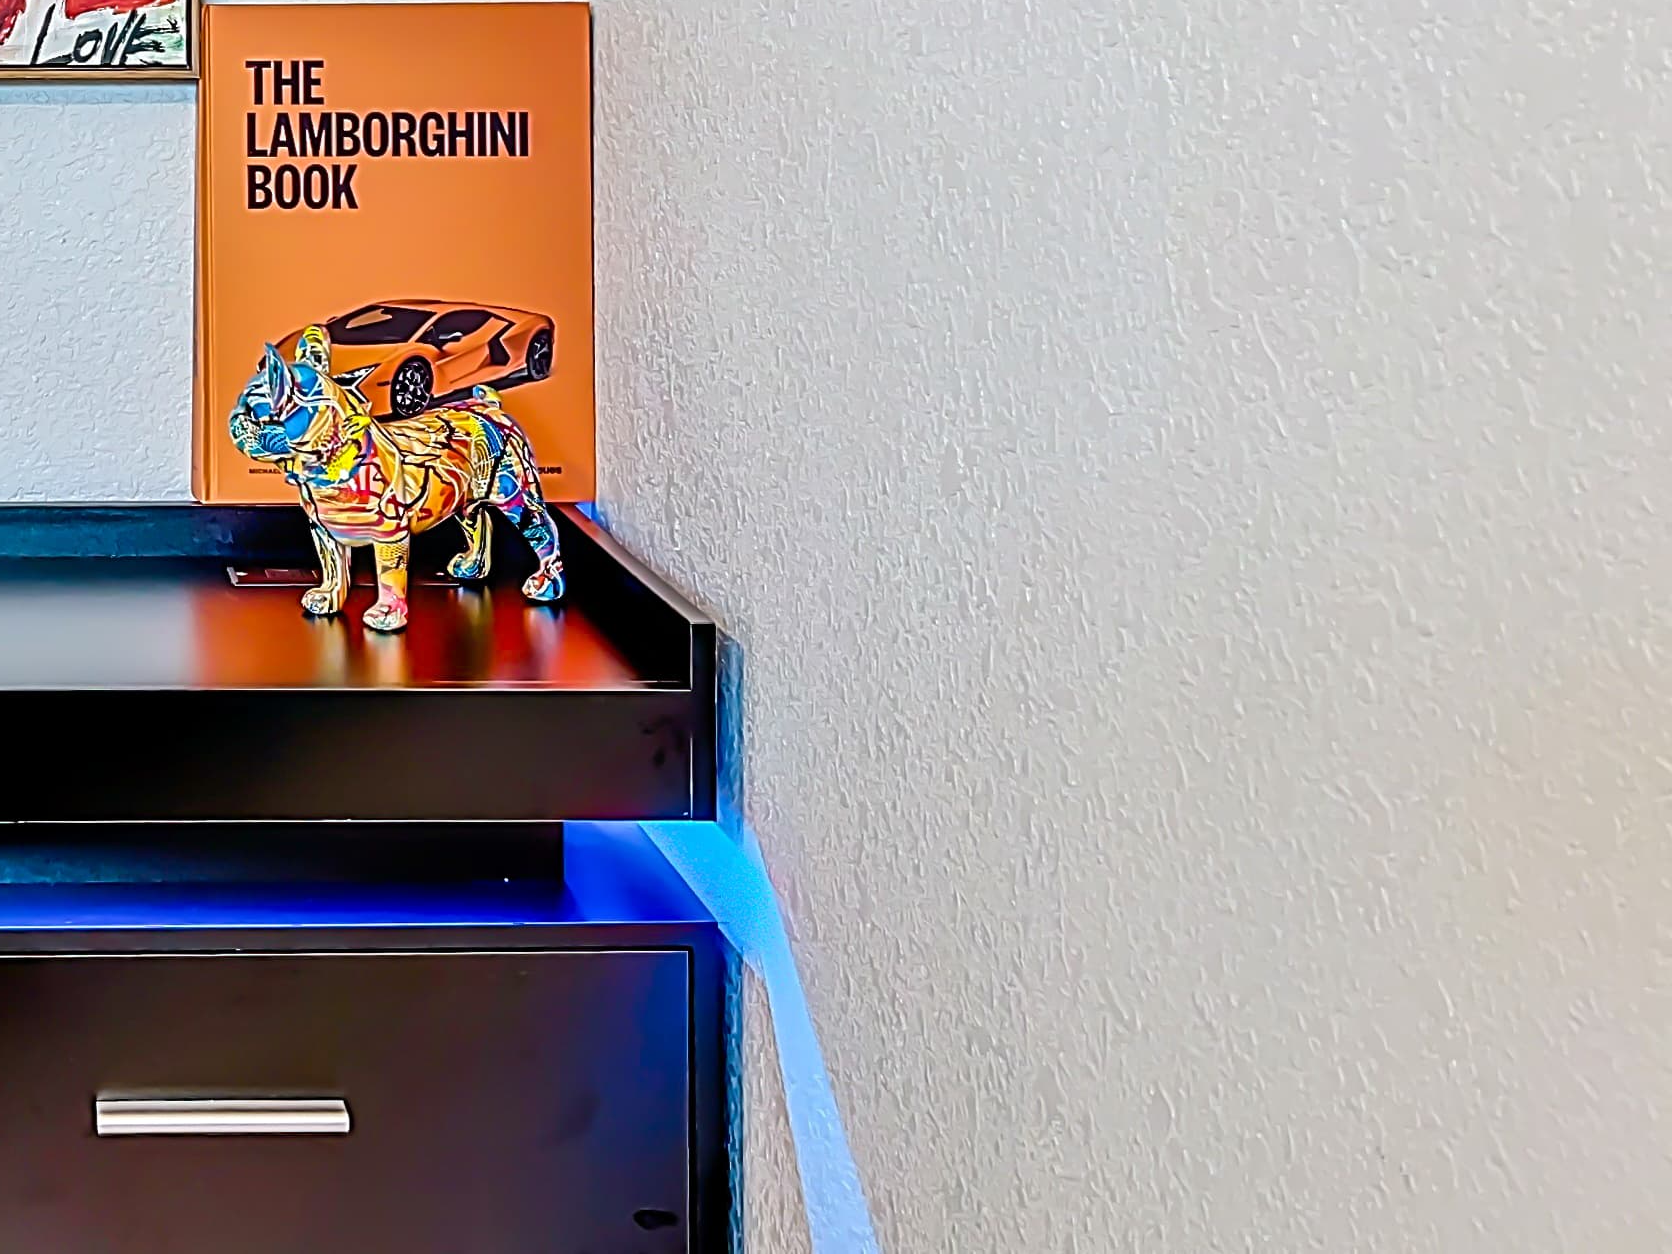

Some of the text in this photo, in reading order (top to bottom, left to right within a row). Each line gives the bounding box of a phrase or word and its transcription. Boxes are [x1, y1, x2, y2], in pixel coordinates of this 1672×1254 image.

[245, 60, 325, 105] THE
[246, 112, 529, 157] LAMBORGHINI
[247, 164, 359, 209] BOOK
